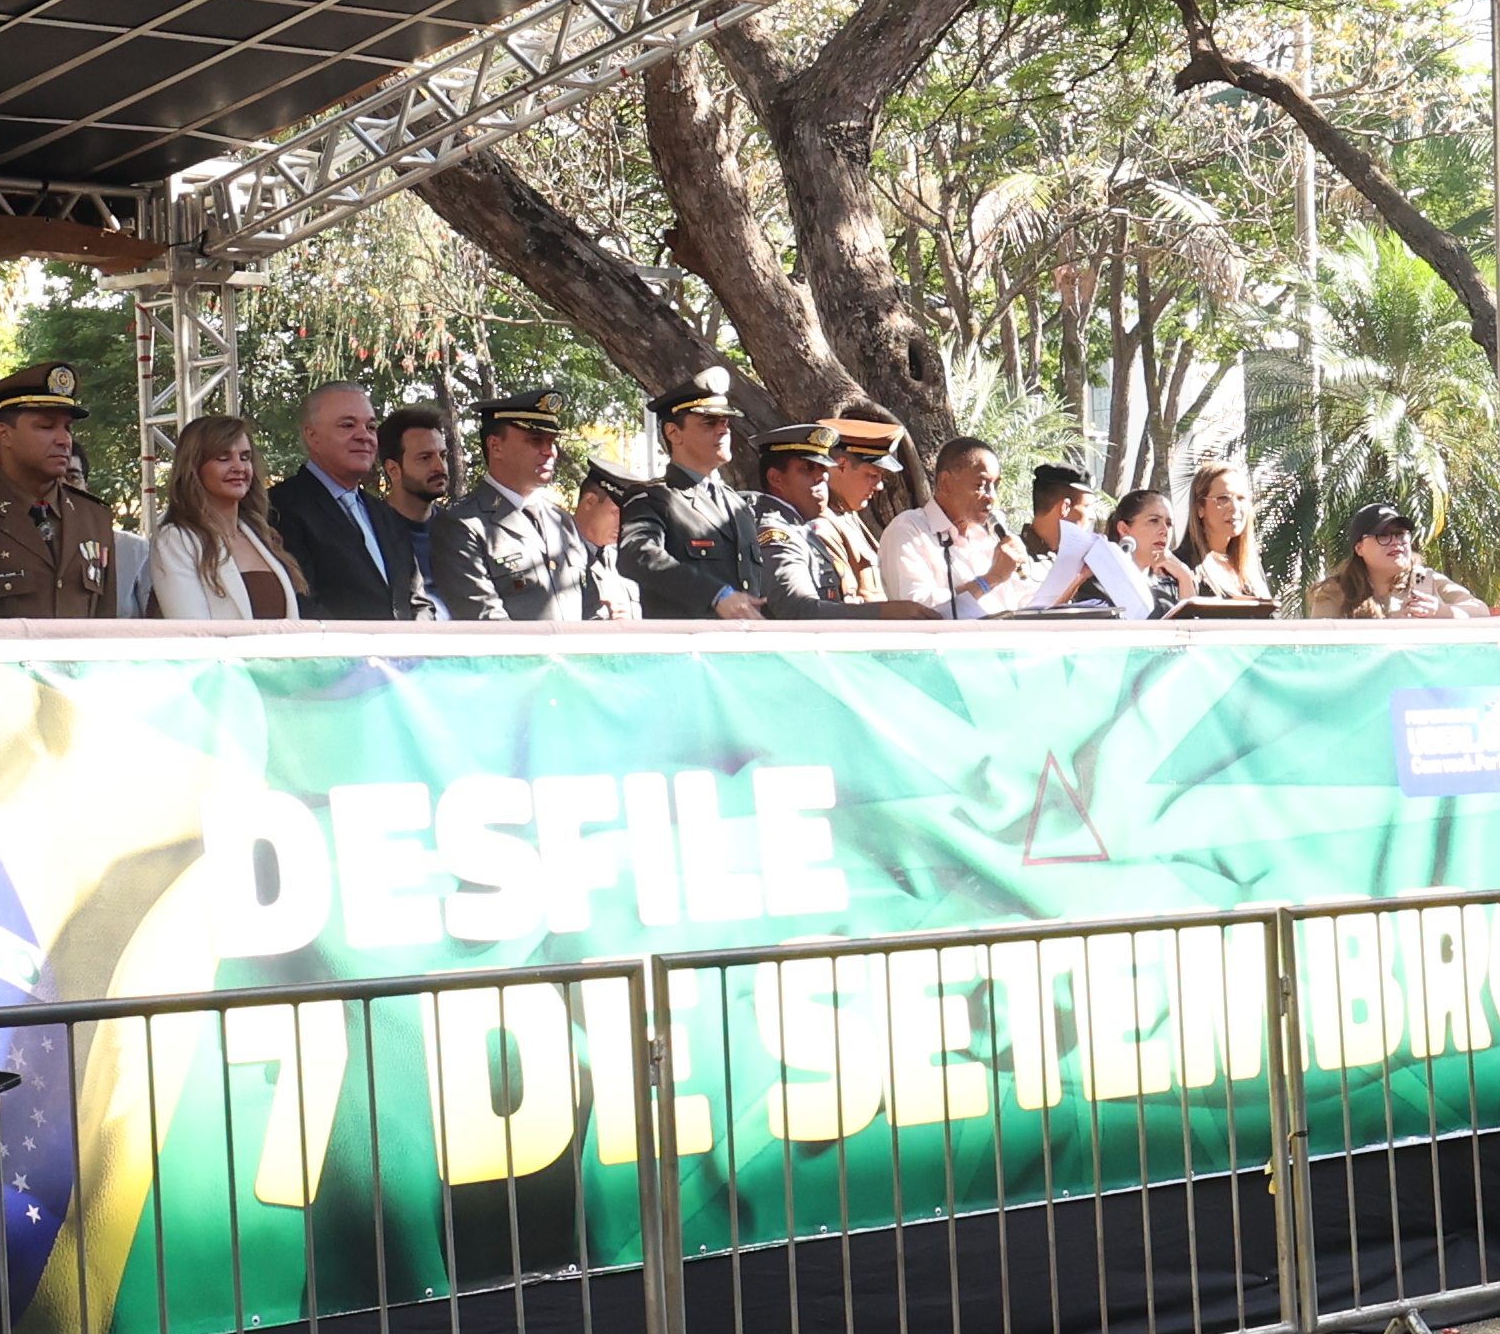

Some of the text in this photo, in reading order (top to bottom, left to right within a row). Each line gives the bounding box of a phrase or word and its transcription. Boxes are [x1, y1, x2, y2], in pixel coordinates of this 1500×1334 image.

[201, 765, 850, 960] DESFILE
[220, 995, 350, 1209] 7
[419, 956, 715, 1188] DE
